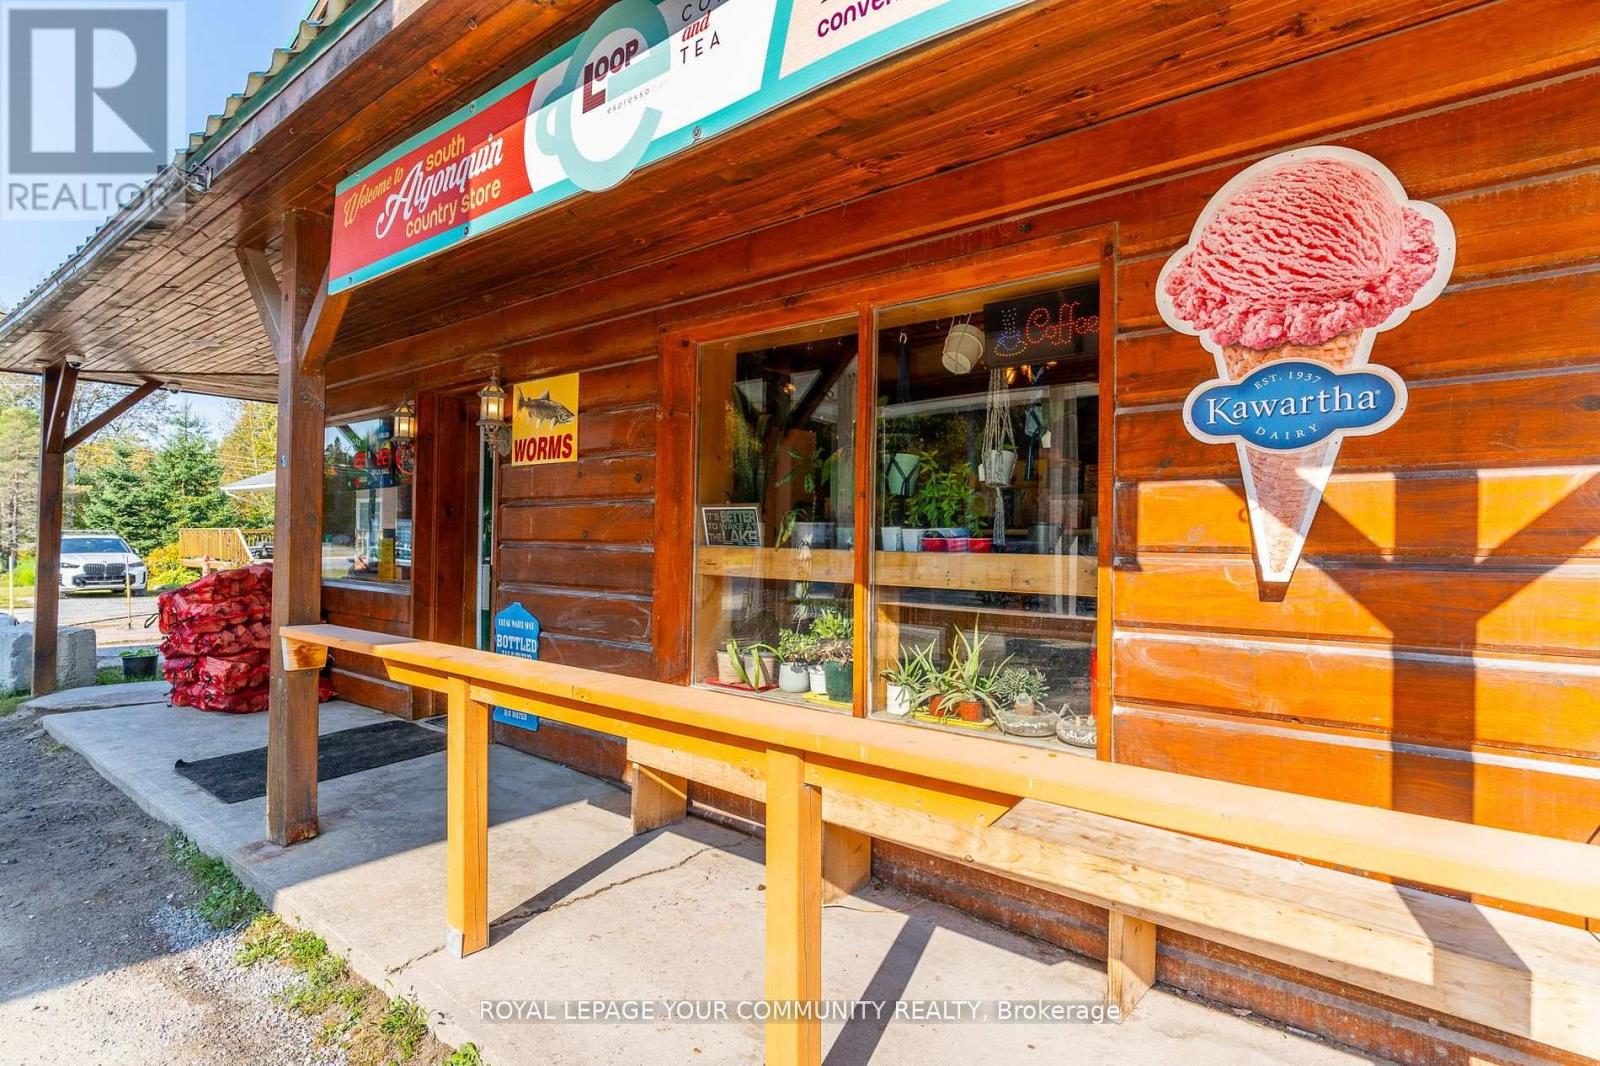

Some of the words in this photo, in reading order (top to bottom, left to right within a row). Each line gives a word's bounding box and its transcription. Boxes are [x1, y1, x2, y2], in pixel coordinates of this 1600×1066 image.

[681, 0, 721, 21] CO
[681, 9, 711, 42] and
[817, 0, 898, 37] conve
[680, 29, 720, 64] TEA
[583, 39, 639, 114] LOOP
[607, 88, 650, 114] espresso
[425, 133, 466, 172] south
[344, 175, 392, 228] Welcome
[394, 167, 404, 187] to
[375, 133, 504, 240] Algonquin
[405, 199, 458, 238] country
[461, 178, 501, 213] store
[1254, 373, 1283, 390] EST.
[1288, 371, 1322, 385] 1937
[1206, 385, 1379, 426] Kawartha
[514, 433, 573, 463] WORMS
[1255, 423, 1320, 440] DAIRY
[720, 511, 756, 522] BETTER
[722, 530, 758, 543] LAKE
[496, 633, 537, 653] BOTTLED
